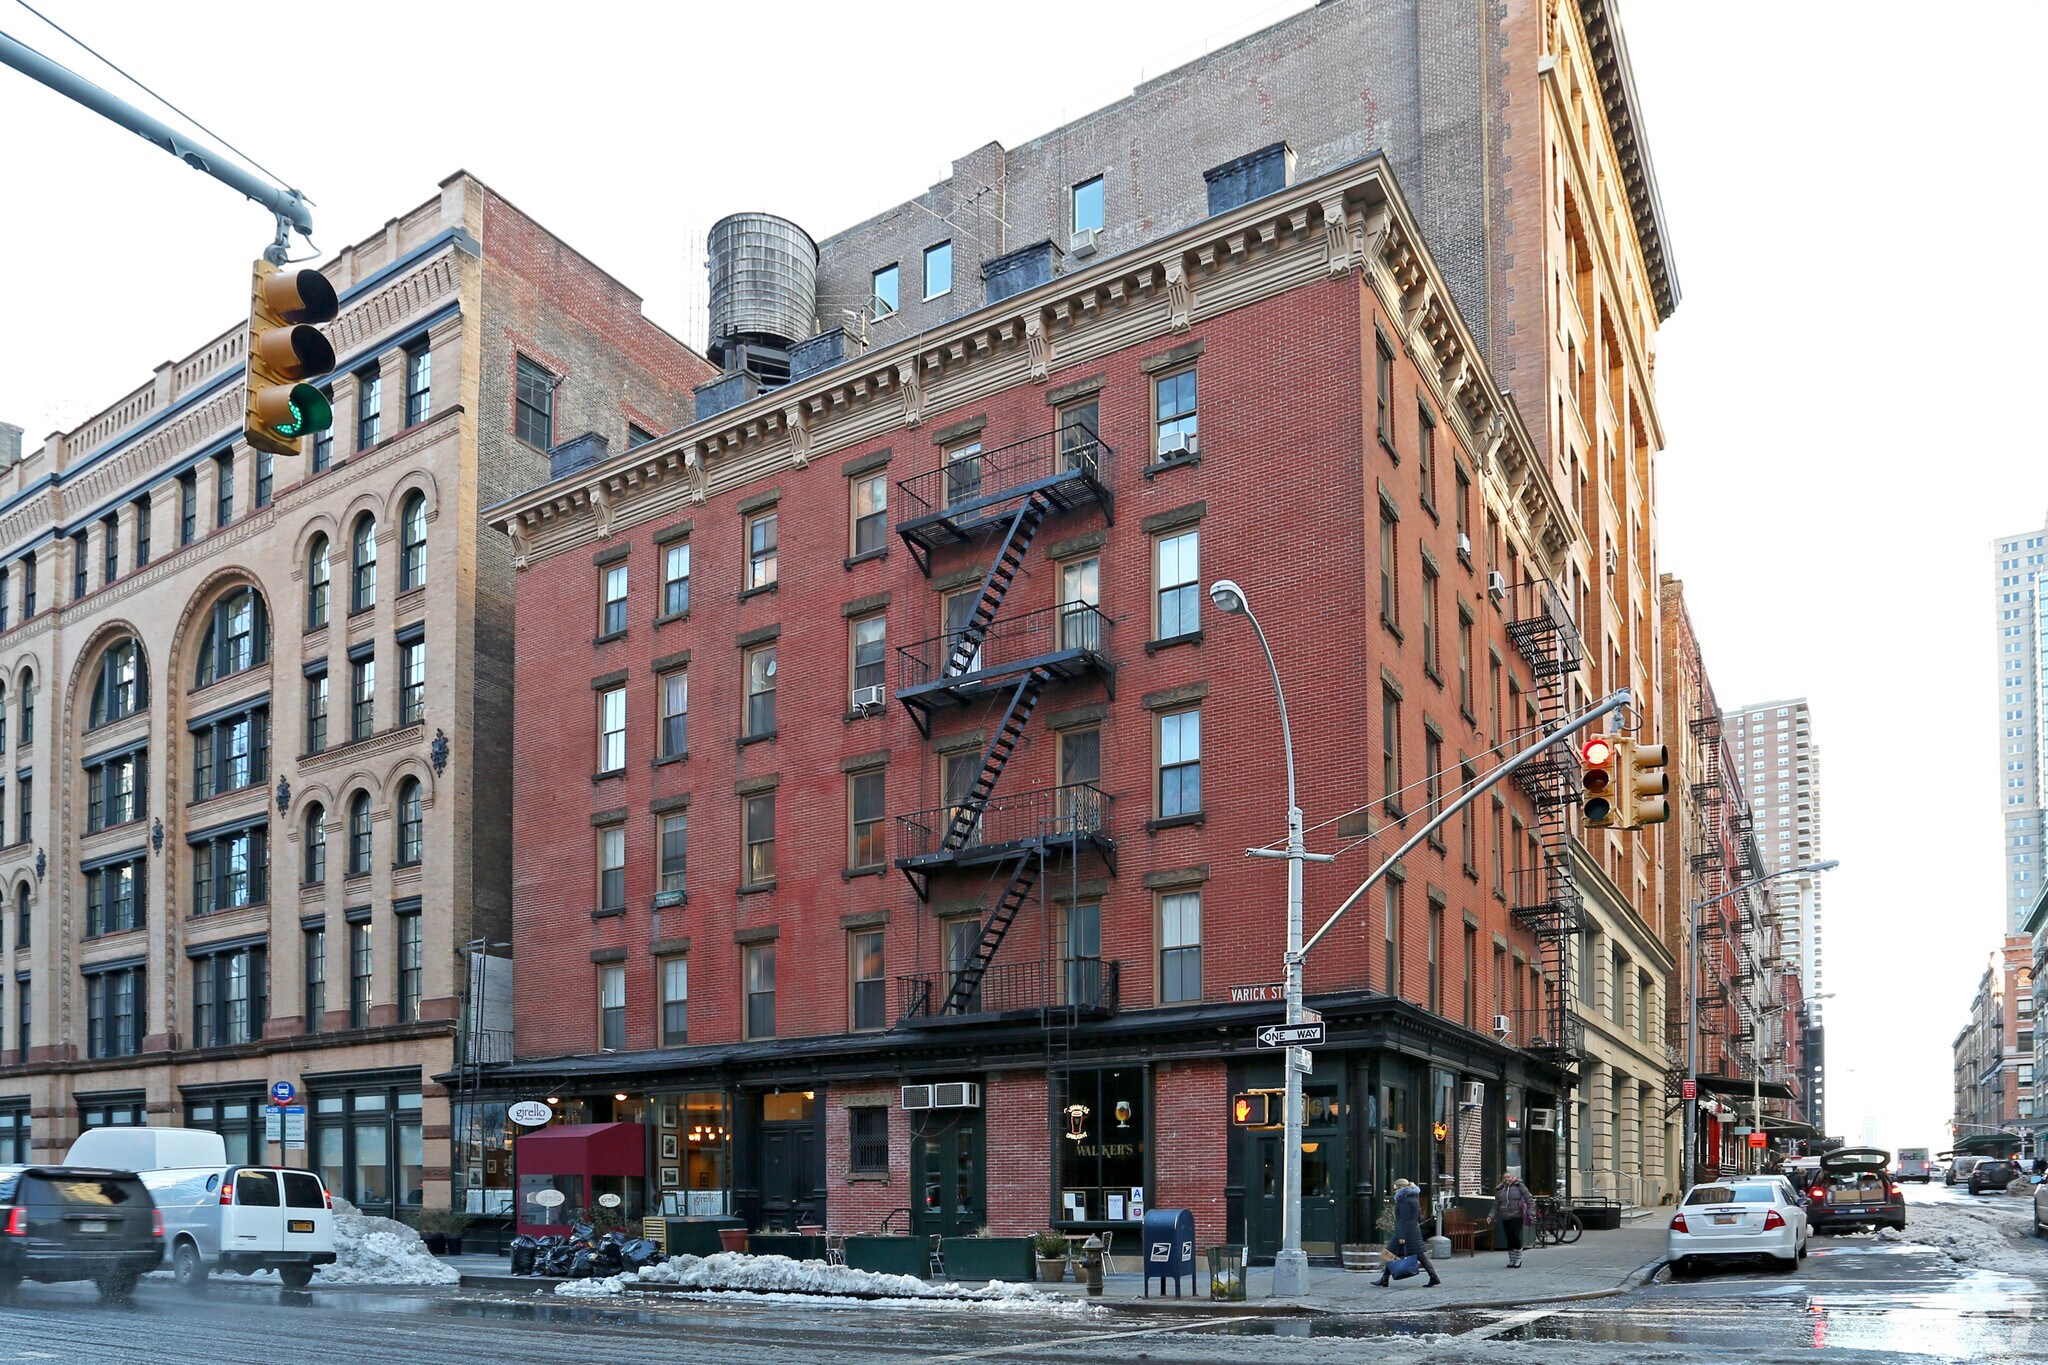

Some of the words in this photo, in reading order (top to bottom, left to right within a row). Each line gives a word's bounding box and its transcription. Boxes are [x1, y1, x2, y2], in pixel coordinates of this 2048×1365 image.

[1231, 987, 1266, 1002] VARICK
[1271, 986, 1283, 999] ST
[1264, 1031, 1286, 1042] ONE
[1296, 1029, 1318, 1039] WAY
[516, 1103, 546, 1121] girello
[1076, 1144, 1134, 1158] WALKER'S
[693, 1192, 717, 1206] girello
[1133, 1189, 1141, 1198] A
